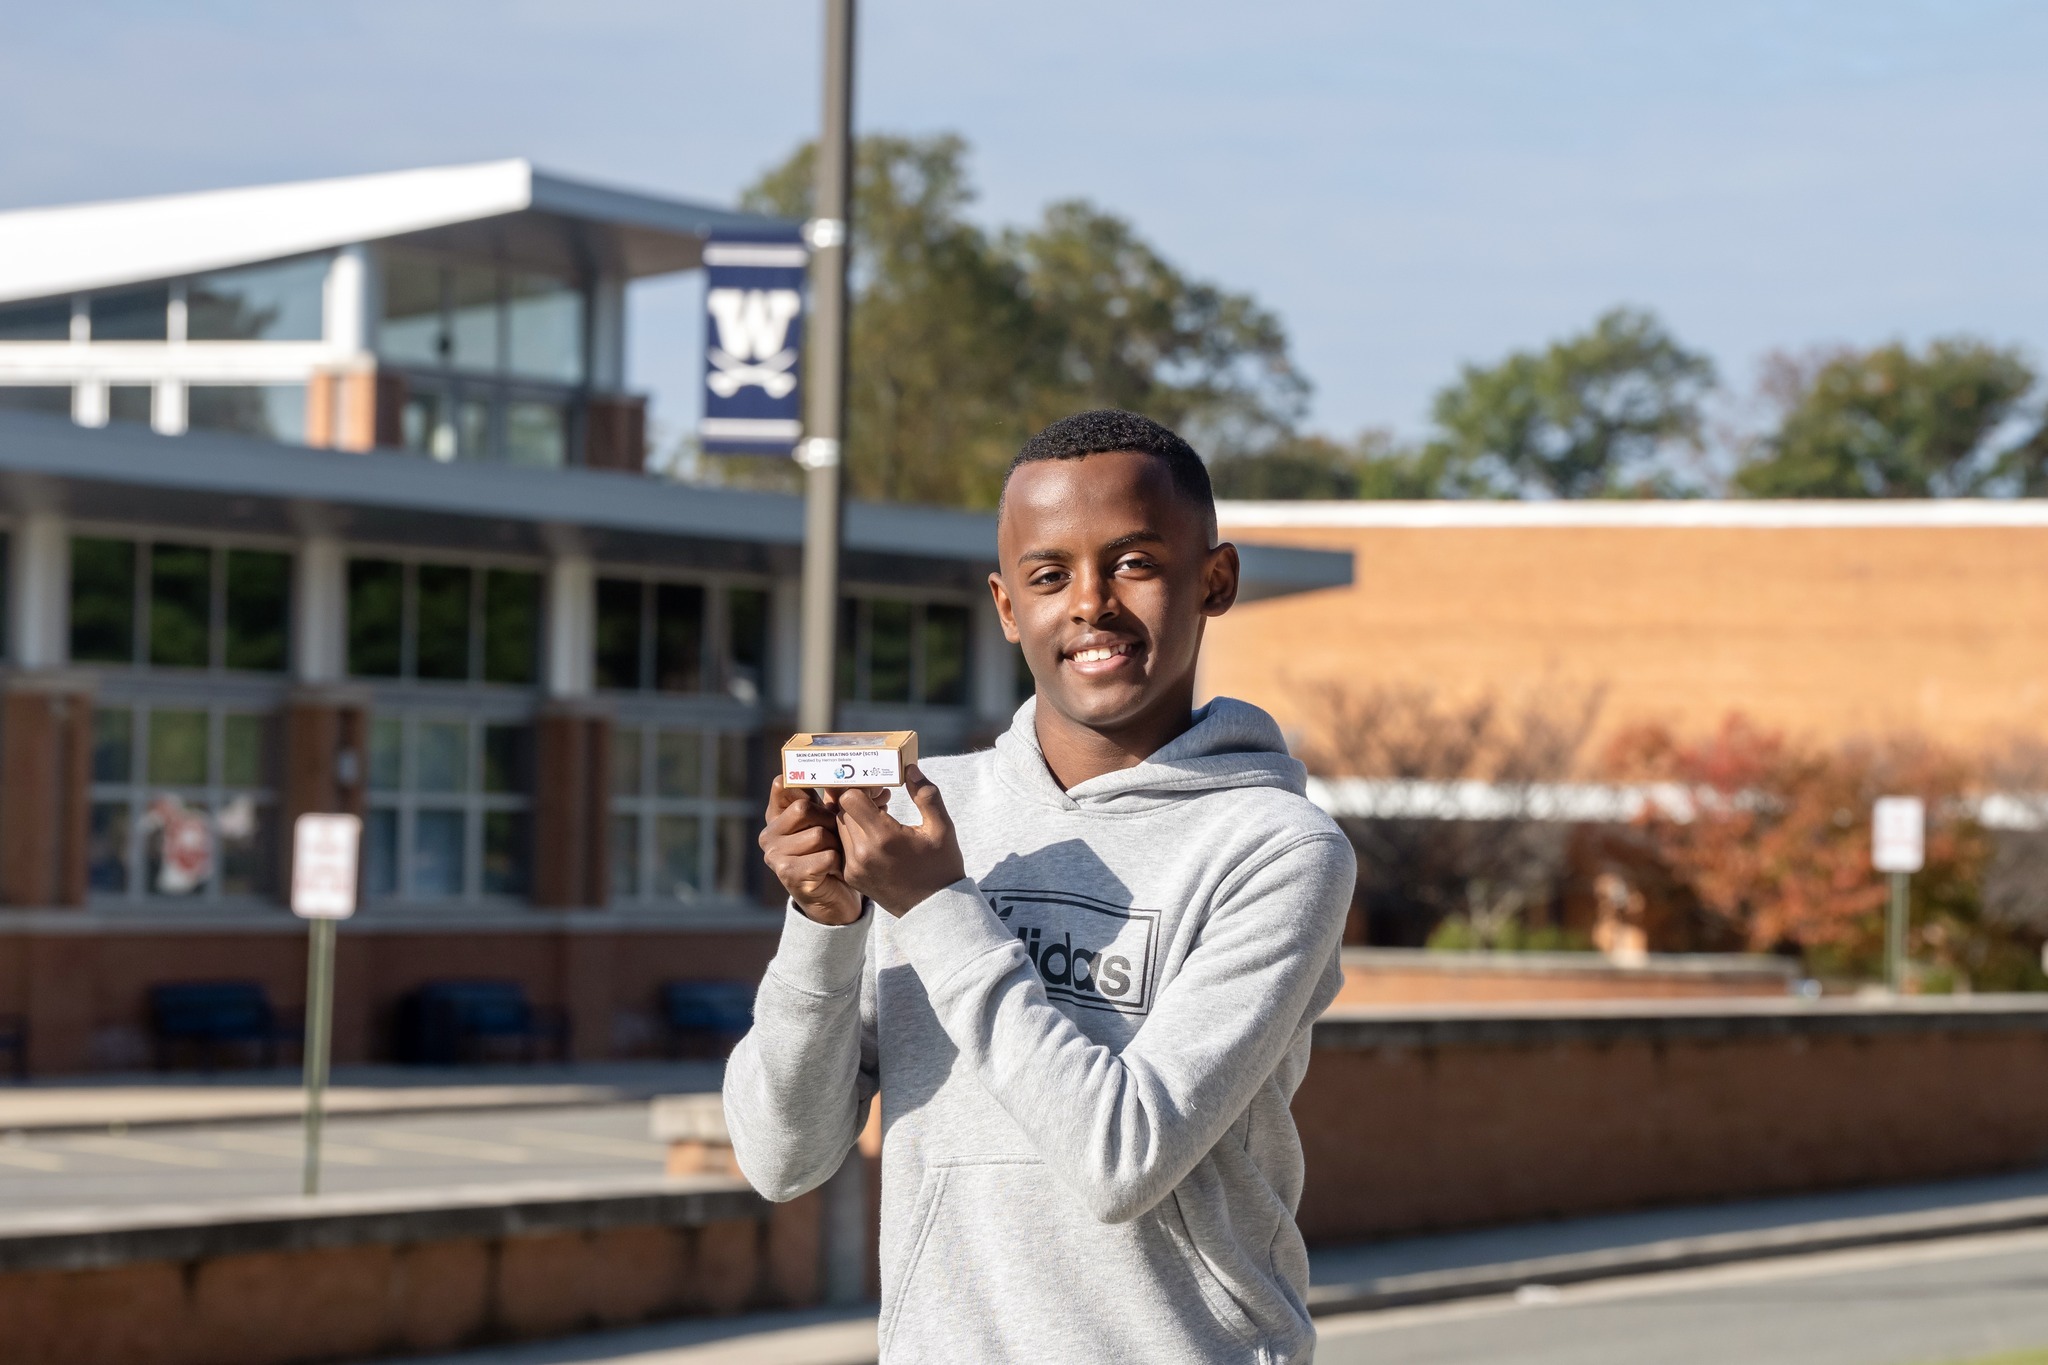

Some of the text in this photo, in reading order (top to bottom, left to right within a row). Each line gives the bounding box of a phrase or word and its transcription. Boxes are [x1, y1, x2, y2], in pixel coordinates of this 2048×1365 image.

[707, 287, 800, 361] W
[789, 771, 805, 780] 3M
[1017, 926, 1132, 997] idas
